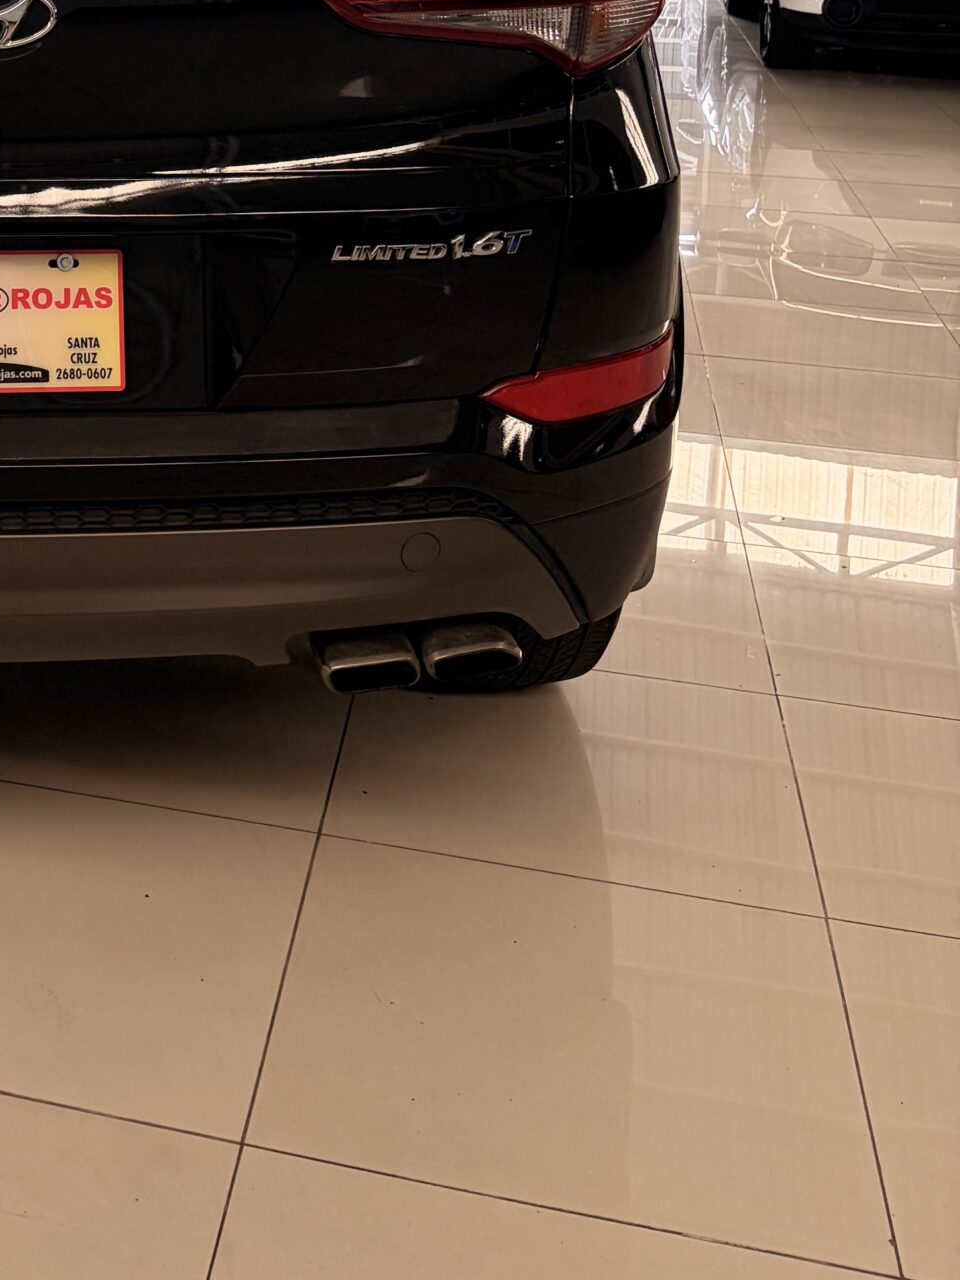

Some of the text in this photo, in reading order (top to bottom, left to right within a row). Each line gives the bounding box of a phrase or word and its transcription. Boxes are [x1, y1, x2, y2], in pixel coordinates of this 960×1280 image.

[331, 243, 448, 261] LIMITED
[11, 287, 113, 310] ROJAS
[67, 337, 100, 349] SANTA
[70, 352, 98, 364] CRUZ
[56, 368, 113, 380] 2680-0607
